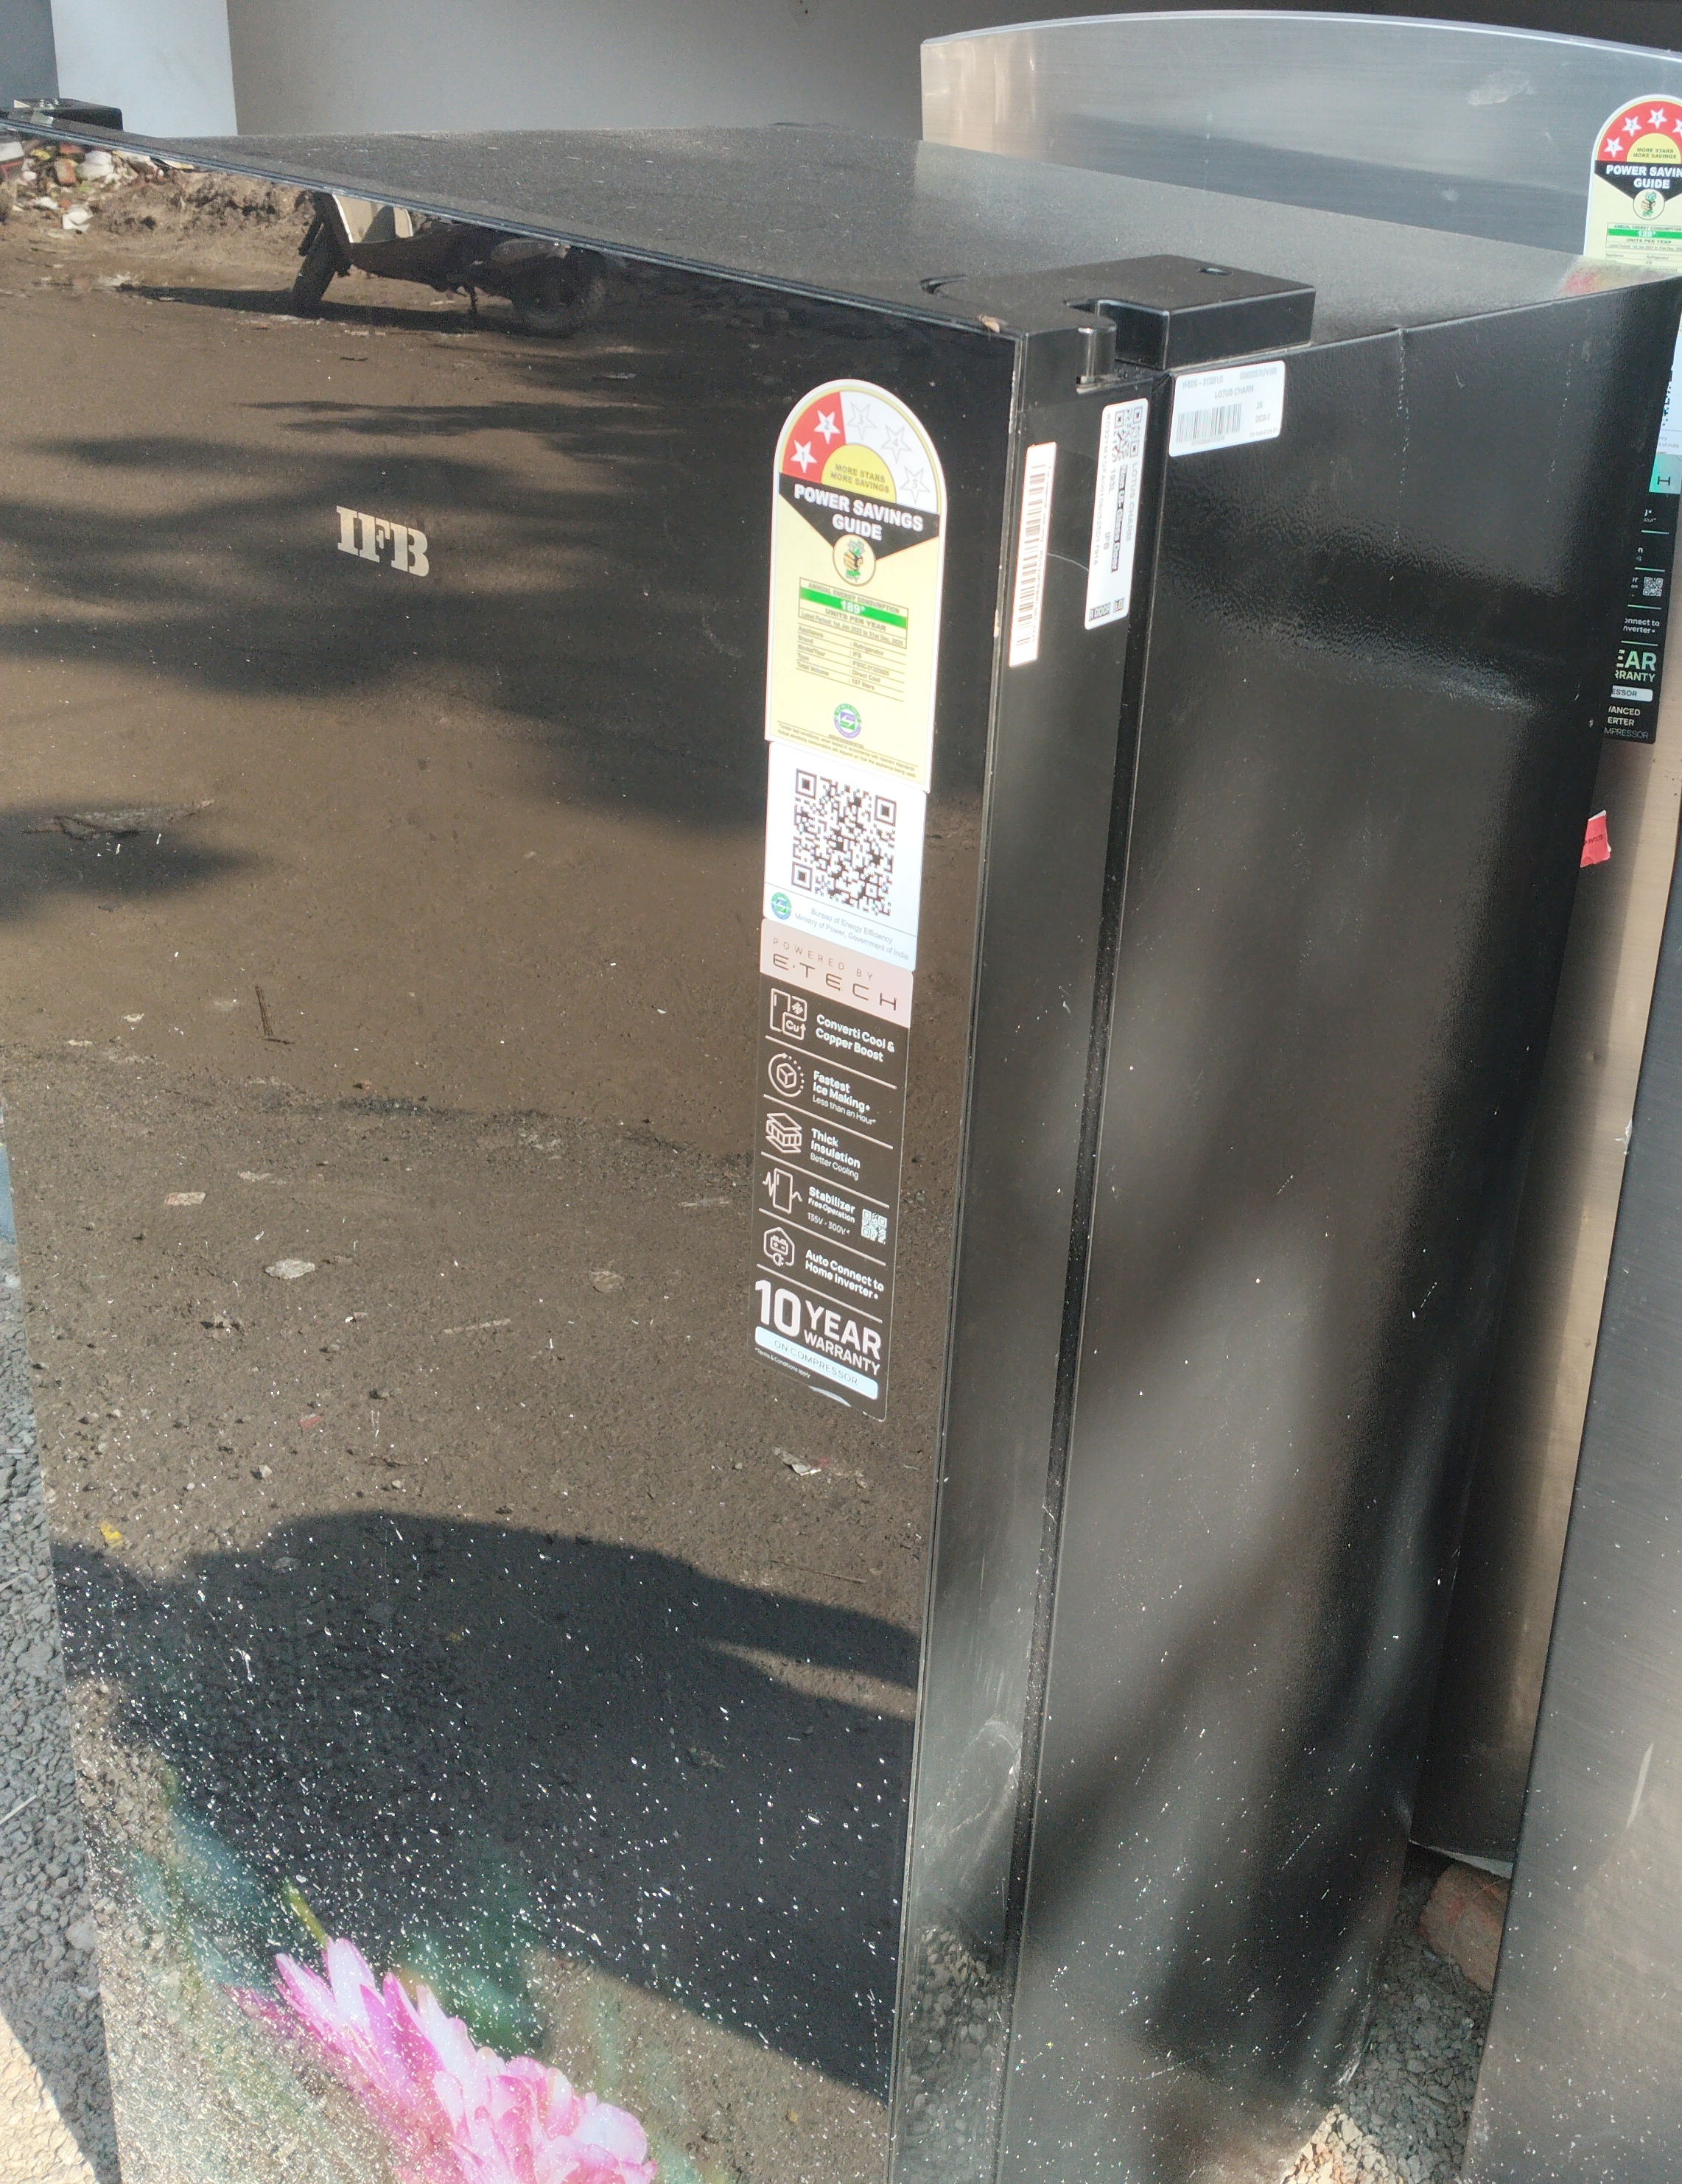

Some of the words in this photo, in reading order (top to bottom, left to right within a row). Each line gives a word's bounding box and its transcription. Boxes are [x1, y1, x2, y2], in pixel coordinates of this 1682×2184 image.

[1606, 164, 1647, 176] POWER
[1633, 178, 1670, 189] GUIDE
[1214, 387, 1233, 399] LOTUS
[1234, 385, 1254, 395] CHARM
[824, 418, 830, 430] 2
[858, 414, 863, 425] 3
[830, 471, 853, 485] MORE
[855, 478, 889, 494] SAVINGS
[835, 464, 858, 477] MORE
[860, 470, 886, 483] STARS
[912, 480, 918, 489] 5
[794, 483, 850, 513] POWER
[853, 499, 924, 532] SAVINGS
[833, 514, 883, 541] GUIDE
[1126, 502, 1135, 541] CHARM
[336, 505, 430, 577] IFB
[807, 583, 831, 594] ANNUAL
[833, 589, 856, 601] ENERGY
[857, 595, 900, 614] CONSUMPTION
[825, 608, 847, 620] UNITS
[849, 616, 864, 626] PER
[866, 620, 886, 632] YEAR
[797, 626, 824, 638] Appliance
[852, 642, 884, 656] Refrigerator
[869, 630, 880, 639] 31st
[797, 661, 809, 670] Total
[797, 653, 810, 663] Type
[852, 670, 868, 679] Direct
[868, 674, 881, 683] Cool
[1604, 726, 1650, 740] MPRESSOR
[1608, 716, 1635, 726] ERTER
[795, 912, 818, 928] Ministry
[819, 921, 825, 929] of
[826, 922, 847, 938] Power,
[848, 930, 886, 952] Government
[886, 944, 893, 953] of
[894, 948, 909, 961] India
[811, 907, 833, 921] Bureau
[833, 916, 840, 924] of
[841, 919, 862, 934] Energy
[863, 927, 893, 944] Efficiency
[773, 937, 844, 971] POWERED
[856, 968, 874, 981] BY
[785, 1019, 800, 1033] Cu
[816, 1014, 861, 1040] Converti
[862, 1031, 886, 1049] Cool
[887, 1041, 895, 1053] &
[816, 1028, 853, 1050] Copper
[853, 1042, 884, 1062] Boost
[813, 1070, 850, 1093] Fastest
[813, 1082, 828, 1095] Ice
[813, 1095, 828, 1108] Less
[830, 1102, 846, 1115] than
[846, 1109, 855, 1119] an
[812, 1127, 838, 1148] Thick
[810, 1140, 861, 1168] Insulation
[810, 1152, 832, 1168] Better
[833, 1162, 859, 1181] Cooling
[807, 1197, 822, 1209] Free
[822, 1204, 855, 1223] Operation
[809, 1186, 856, 1214] Stabilizer
[805, 1260, 833, 1281] Home
[806, 1249, 830, 1268] Auto
[830, 1260, 872, 1287] Connect
[873, 1279, 884, 1293] to
[755, 1279, 802, 1338] 10
[805, 1299, 881, 1360] YEAR
[774, 1339, 788, 1352] ON
[790, 1346, 858, 1386] COMPRESSOR
[803, 1329, 881, 1376] WARRANTY
